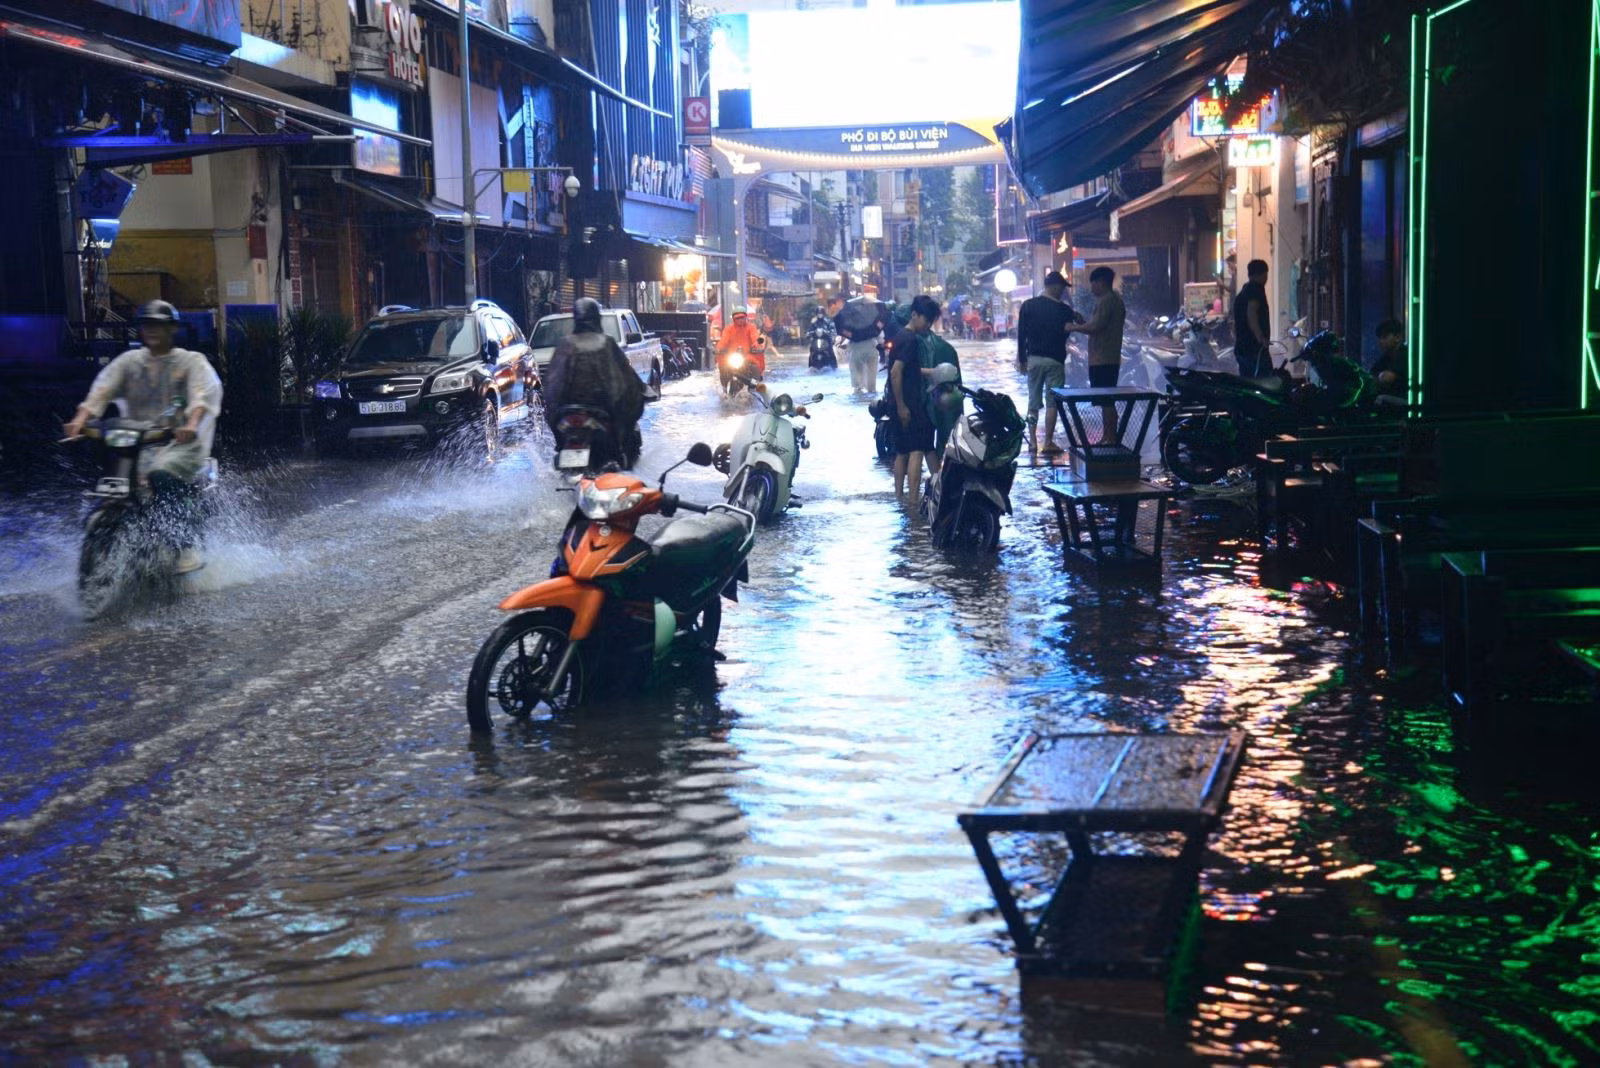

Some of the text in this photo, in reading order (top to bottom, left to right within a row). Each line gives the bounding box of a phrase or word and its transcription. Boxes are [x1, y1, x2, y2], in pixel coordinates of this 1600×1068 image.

[387, 2, 421, 54] OYO
[391, 51, 424, 87] HOTEL
[841, 129, 864, 143] PHỐ
[881, 128, 896, 143] BỘ
[899, 128, 918, 141] BÙI
[921, 126, 948, 142] VIỆN
